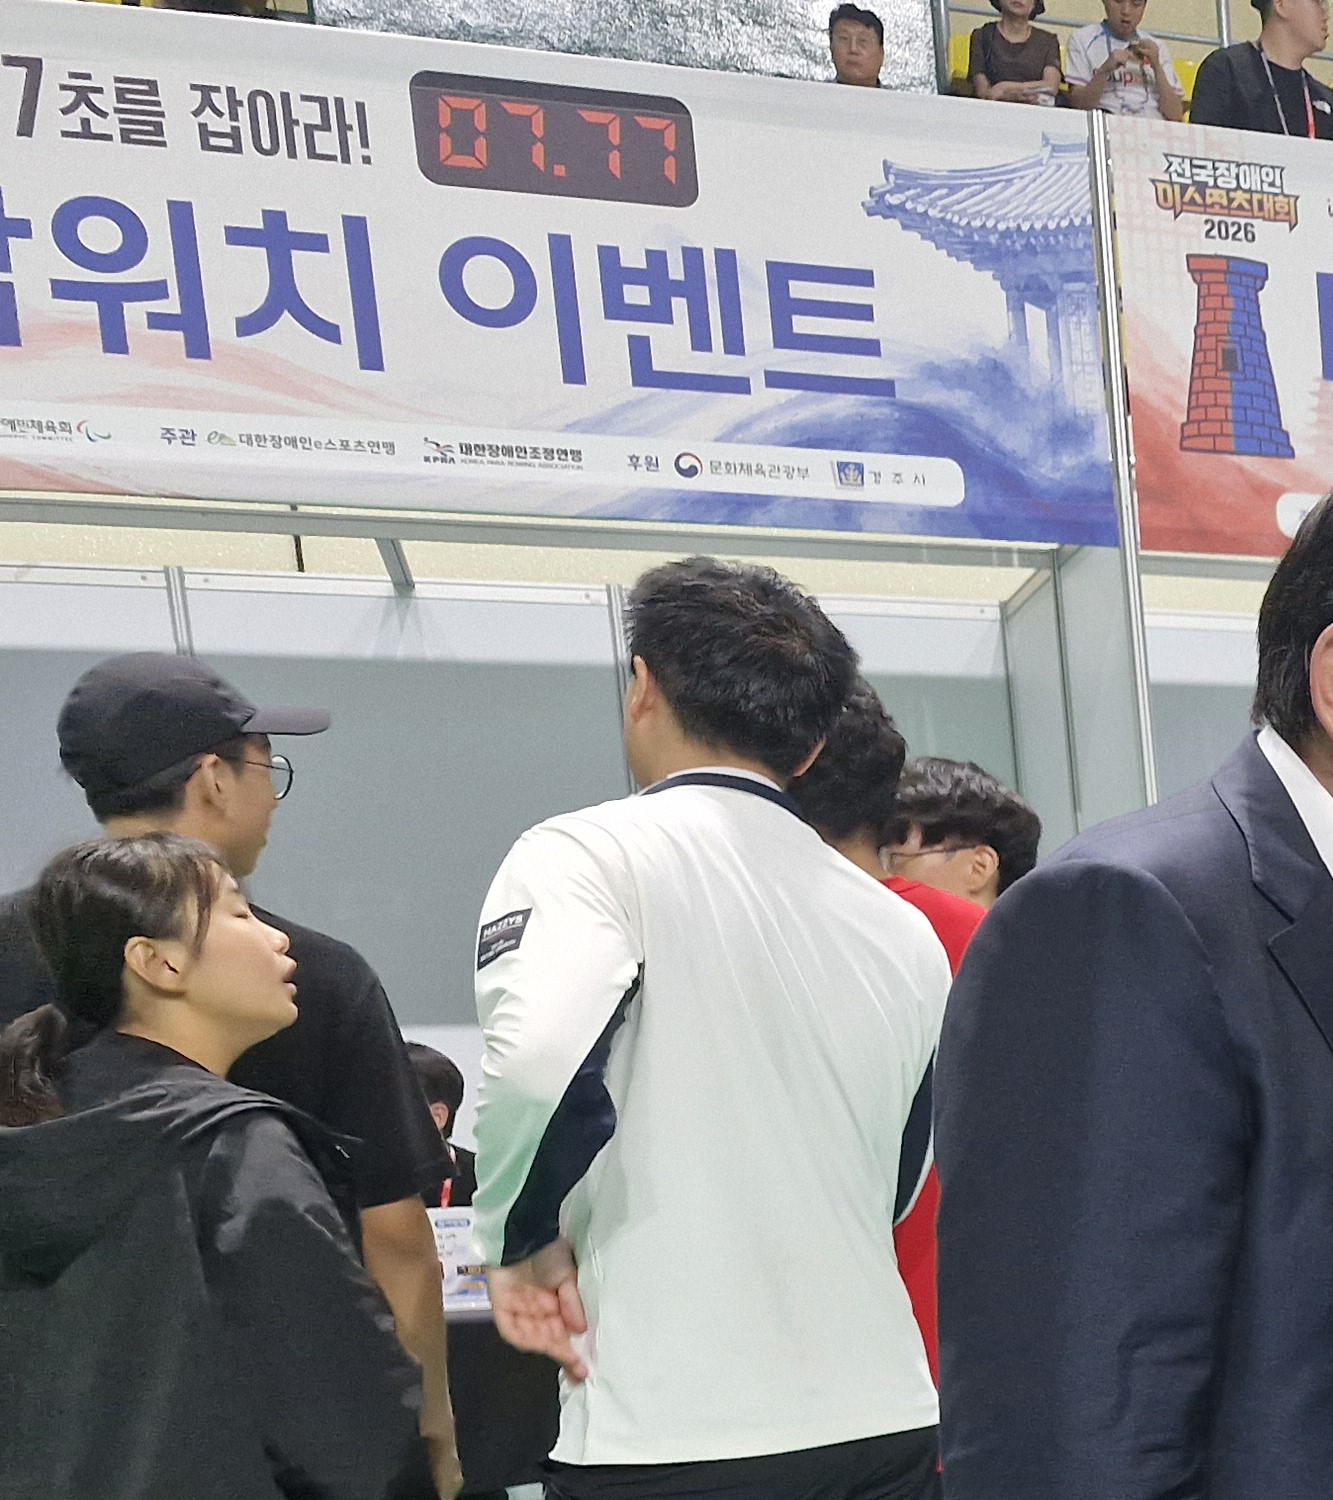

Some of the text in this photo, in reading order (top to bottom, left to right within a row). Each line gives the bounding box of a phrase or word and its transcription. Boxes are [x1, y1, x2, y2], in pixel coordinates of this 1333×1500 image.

[190, 83, 372, 165] 잡아라!
[437, 95, 677, 185] 07.77
[1166, 156, 1283, 193] 전국장애인
[1153, 180, 1299, 226] 이스포츠대회
[1204, 219, 1256, 243] 2026
[438, 232, 896, 398] 이벤트
[160, 427, 395, 455] 주관 대한장애인e스포츠연맹
[623, 453, 660, 473] 후원
[709, 460, 810, 480] 문화체육관광부
